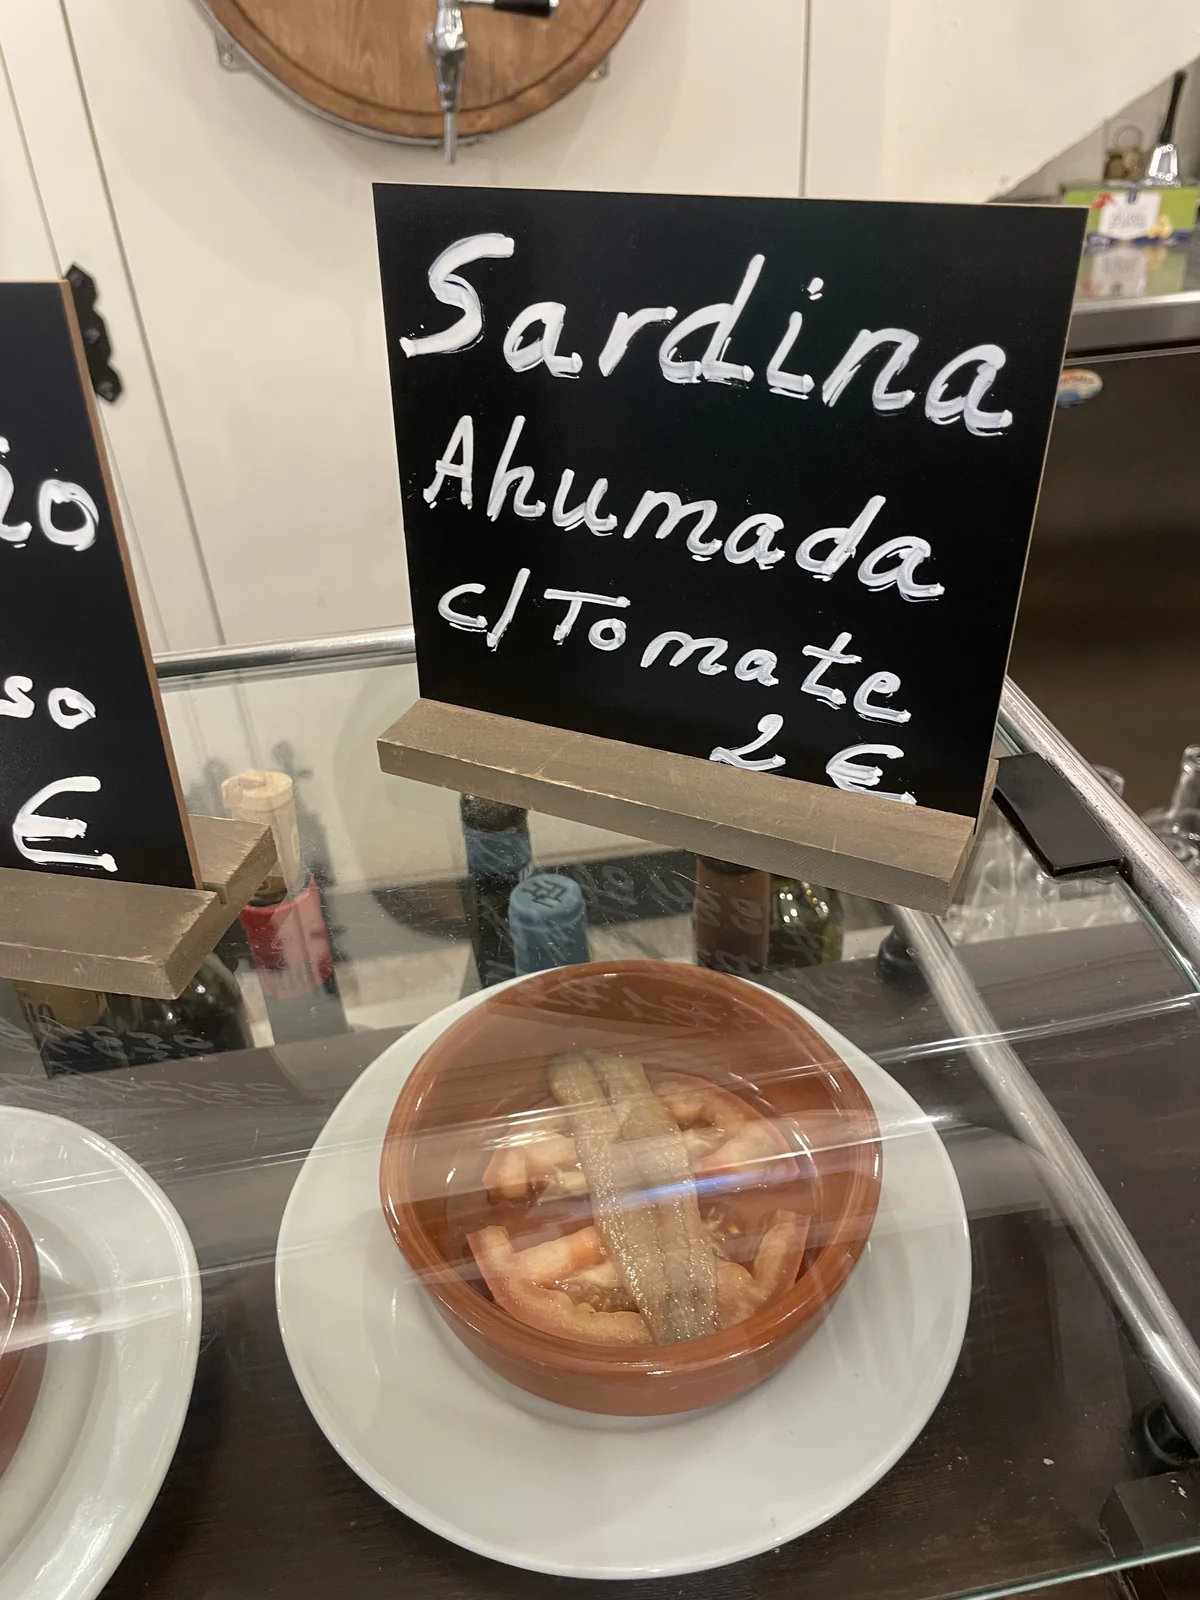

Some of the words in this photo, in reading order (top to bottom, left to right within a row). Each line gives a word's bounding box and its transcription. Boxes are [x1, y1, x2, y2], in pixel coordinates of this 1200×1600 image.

[399, 232, 1013, 437] Sardina
[423, 415, 945, 602] Ahumada
[709, 713, 786, 771] 2
[825, 744, 917, 805] €
